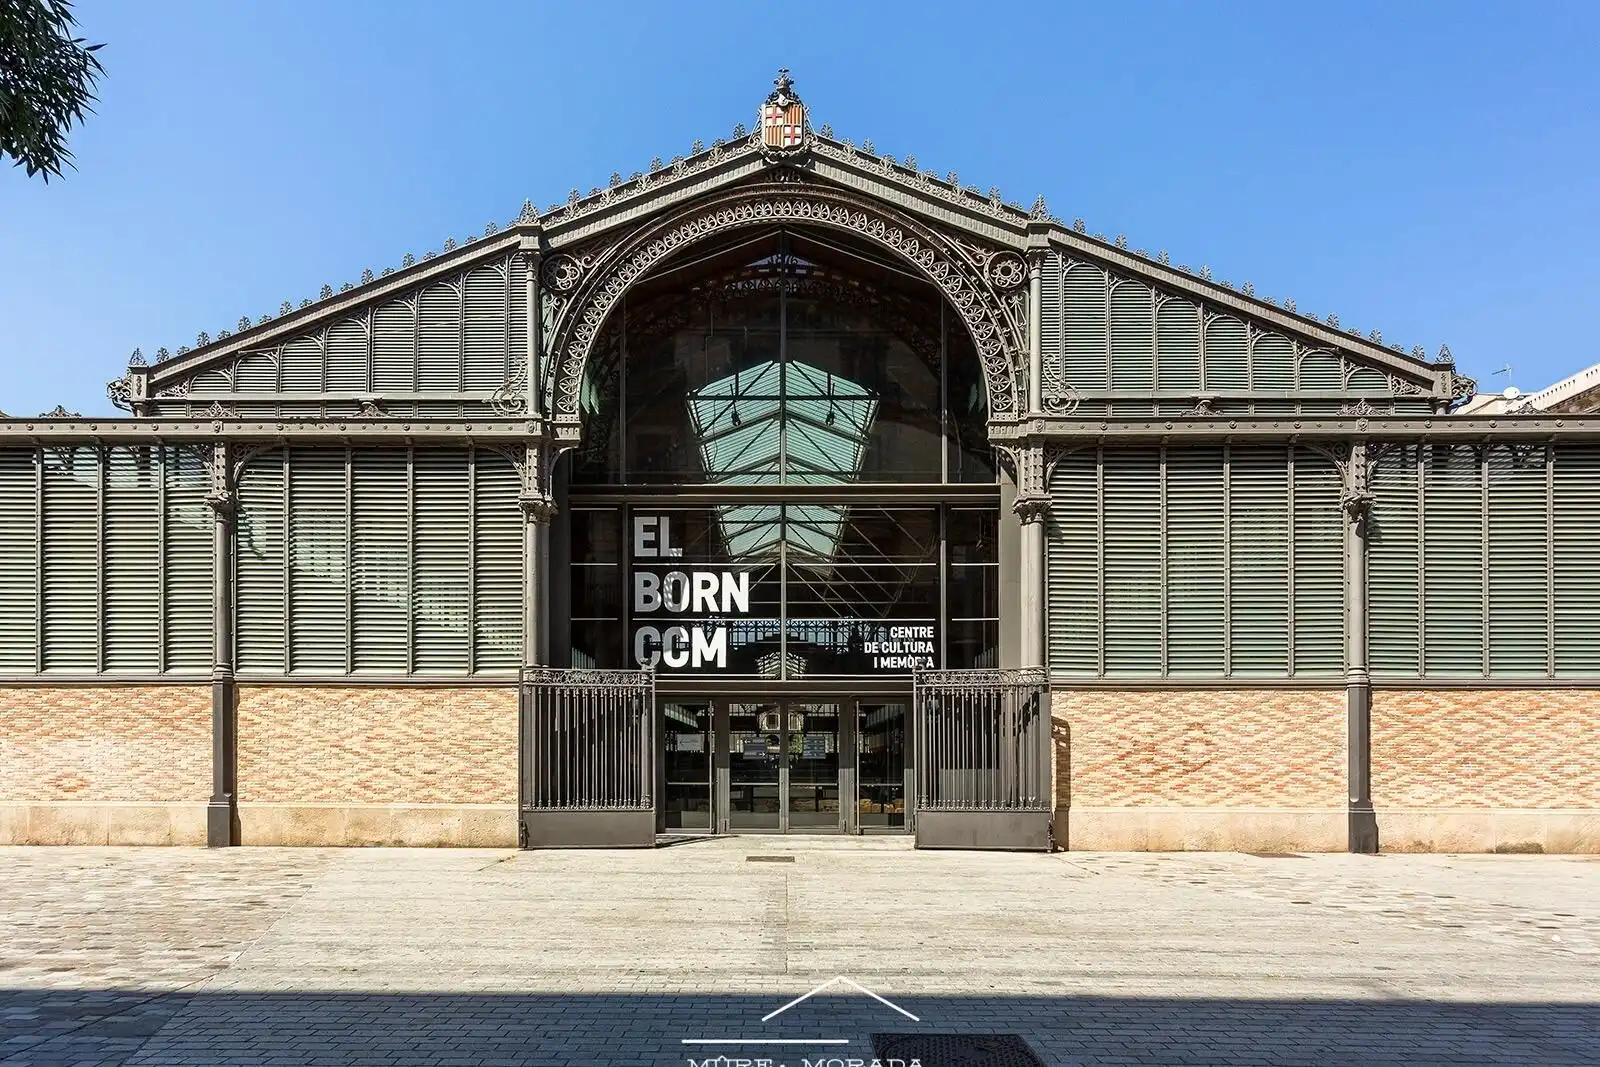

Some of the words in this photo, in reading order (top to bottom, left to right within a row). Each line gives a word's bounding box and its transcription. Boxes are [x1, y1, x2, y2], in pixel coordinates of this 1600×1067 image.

[634, 516, 683, 557] EL
[634, 571, 750, 613] BORN
[634, 625, 727, 668] CCM
[890, 626, 934, 639] CENTRE
[864, 641, 879, 654] DE
[881, 641, 935, 654] CULTURA
[873, 656, 878, 669] I
[880, 654, 935, 669] MEMÒRA
